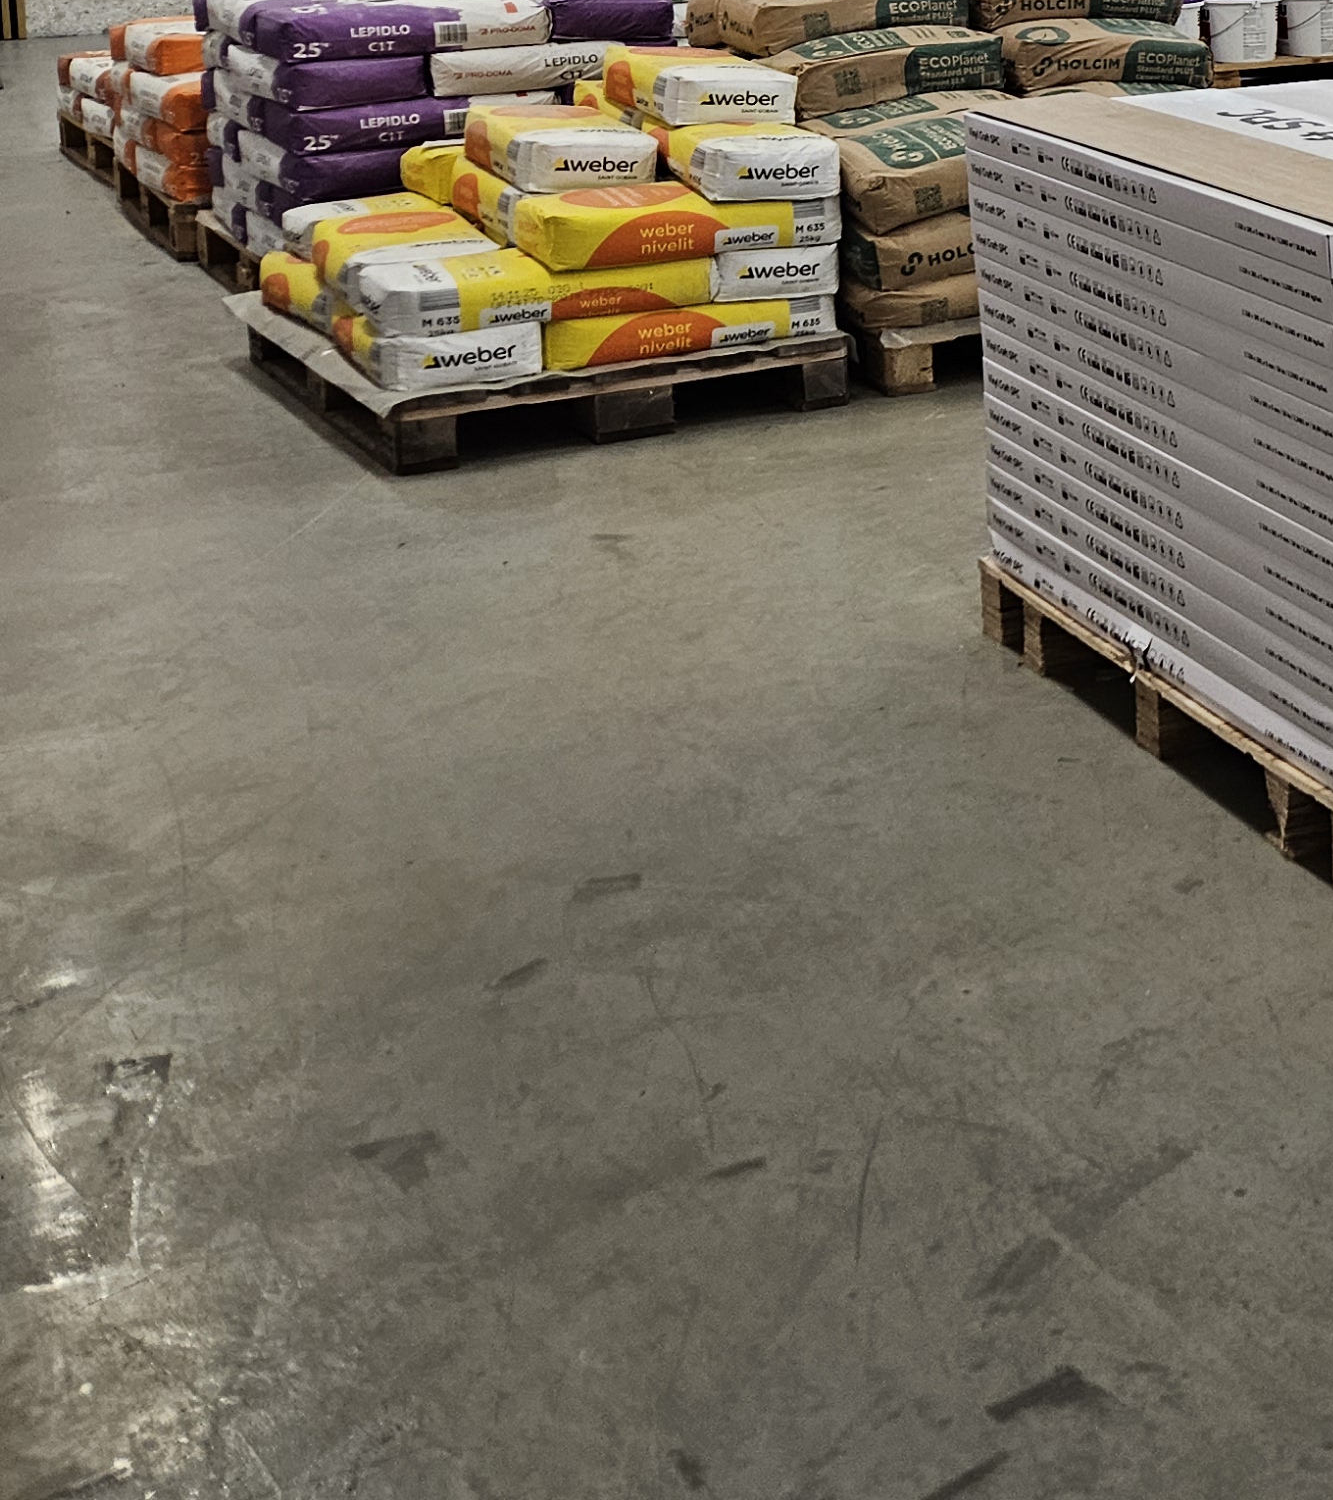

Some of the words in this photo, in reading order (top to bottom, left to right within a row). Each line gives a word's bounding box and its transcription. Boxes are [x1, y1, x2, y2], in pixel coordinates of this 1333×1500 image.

[350, 24, 411, 38] LEPIDLO
[544, 53, 598, 68] LEPIDLO
[920, 52, 989, 69] ECOPlanet
[1057, 58, 1121, 71] HOLCIM
[1138, 51, 1201, 66] ECOPlanet
[713, 90, 780, 106] weber
[360, 113, 421, 129] LEPIDLO
[1216, 108, 1328, 131] SPC
[570, 157, 639, 173] weber
[752, 163, 820, 180] weber
[640, 222, 695, 238] weber
[795, 225, 804, 234] M
[806, 222, 826, 232] 635
[641, 238, 695, 255] nivelit
[752, 259, 821, 279] weber
[637, 320, 692, 339] weber
[639, 336, 693, 355] nivelit
[441, 342, 518, 369] weber
